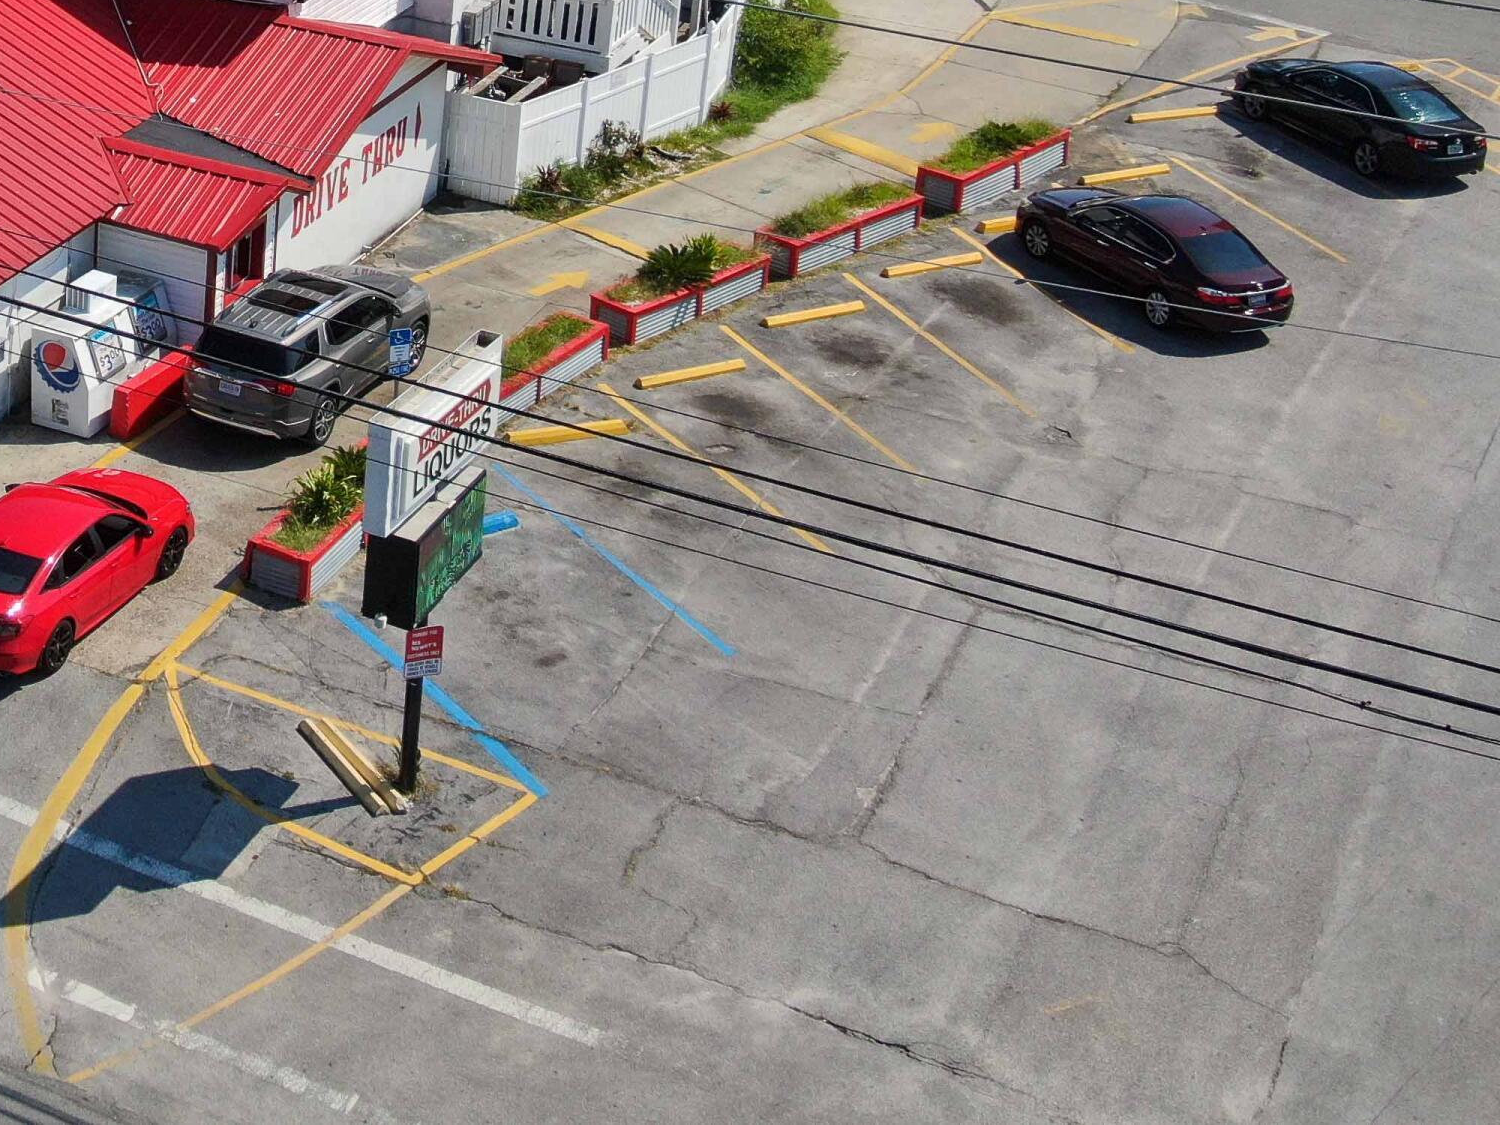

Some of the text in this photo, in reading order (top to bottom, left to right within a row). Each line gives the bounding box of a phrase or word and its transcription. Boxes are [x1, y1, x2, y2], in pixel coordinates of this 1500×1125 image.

[291, 116, 408, 239] DRIVE THRU
[413, 407, 492, 499] LIQUORS
[422, 384, 488, 454] DRIVE-THRU
